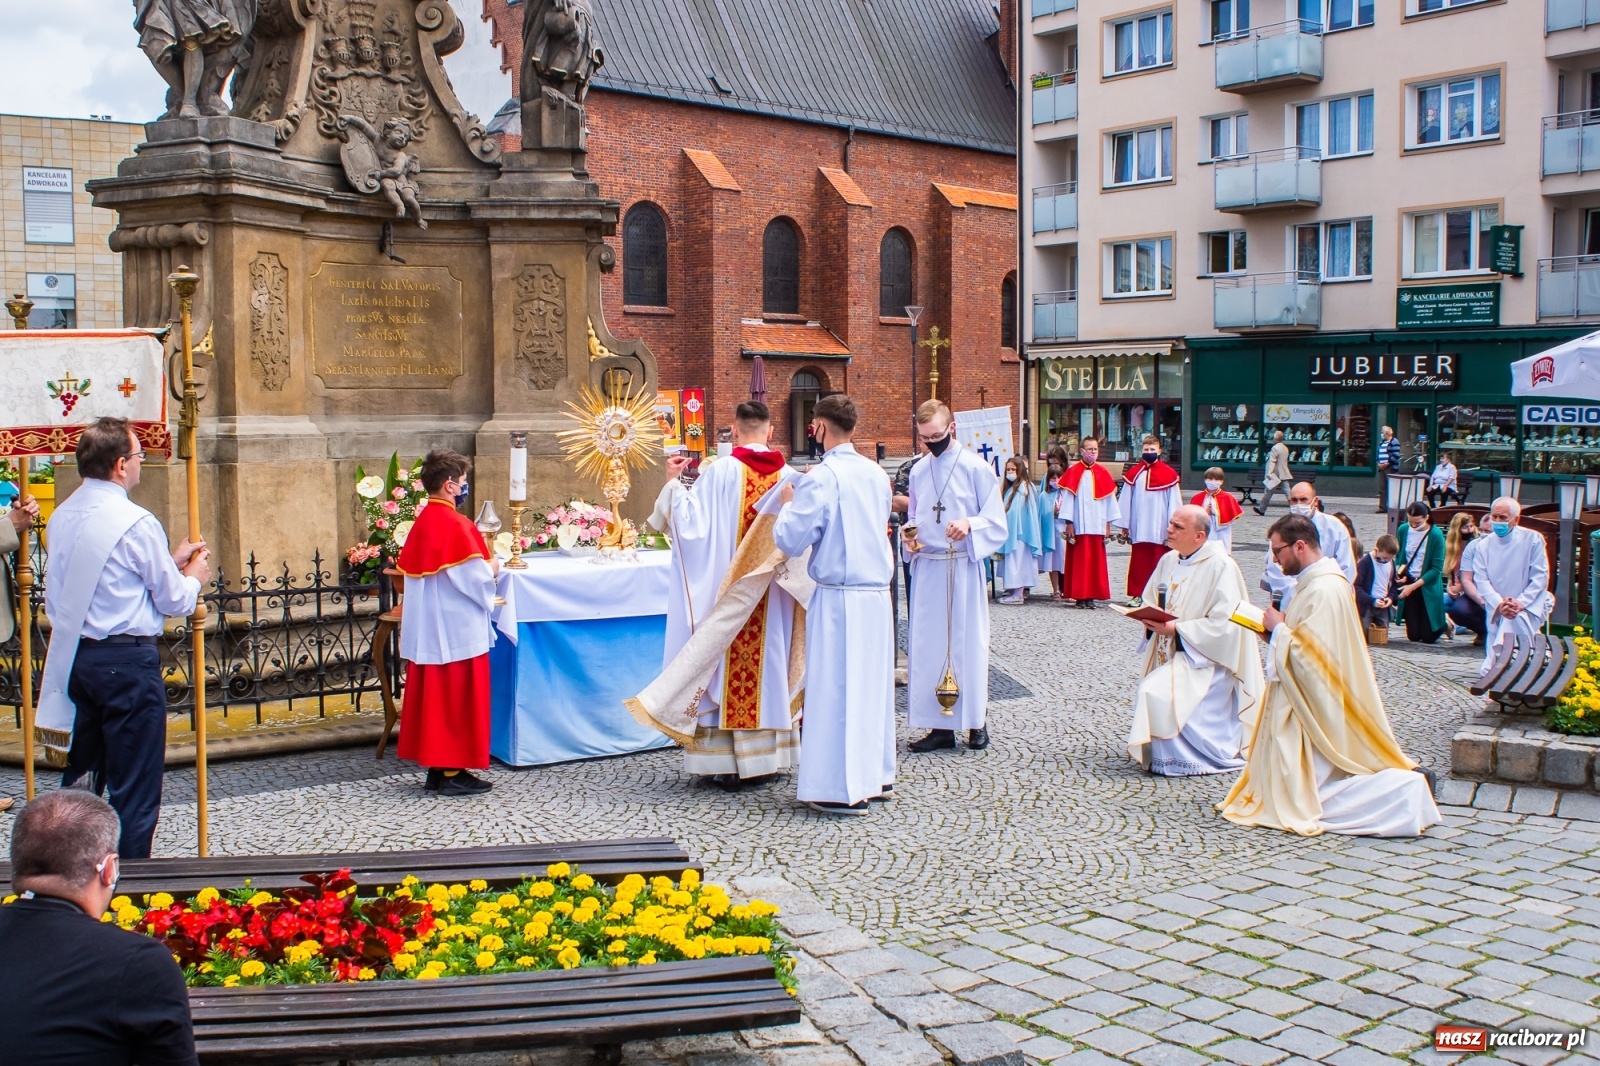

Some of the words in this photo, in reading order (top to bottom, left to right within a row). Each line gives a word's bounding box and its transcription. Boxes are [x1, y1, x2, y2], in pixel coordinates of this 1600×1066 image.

[27, 171, 67, 179] KANCELARIA
[27, 179, 68, 188] ADWOKACKA
[1413, 293, 1450, 301] KANCELARIE
[1452, 291, 1494, 299] ADWOKACKIE
[1311, 355, 1453, 375] JUBILER
[1044, 361, 1149, 392] STELLA
[1401, 376, 1417, 387] M.
[1341, 379, 1365, 387] 1989
[1213, 409, 1231, 419] Ricaud
[1309, 413, 1330, 421] -30%
[1527, 407, 1600, 423] CASIO
